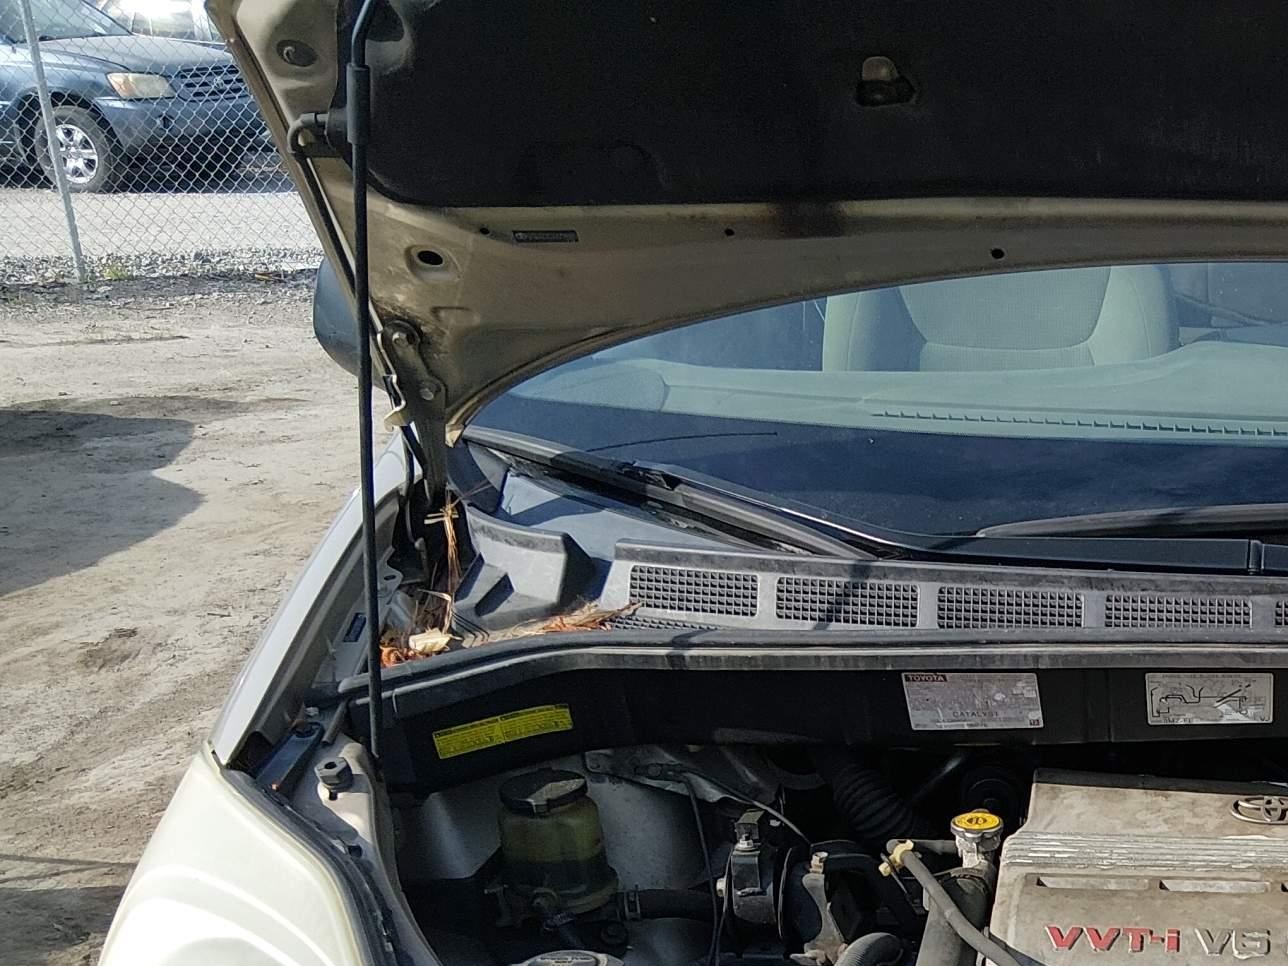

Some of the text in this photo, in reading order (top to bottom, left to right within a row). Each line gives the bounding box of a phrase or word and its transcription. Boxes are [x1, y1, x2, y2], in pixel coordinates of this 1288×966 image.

[909, 674, 944, 682] TOYOTA
[1044, 925, 1183, 954] VVT-i
[1194, 926, 1272, 959] V6
